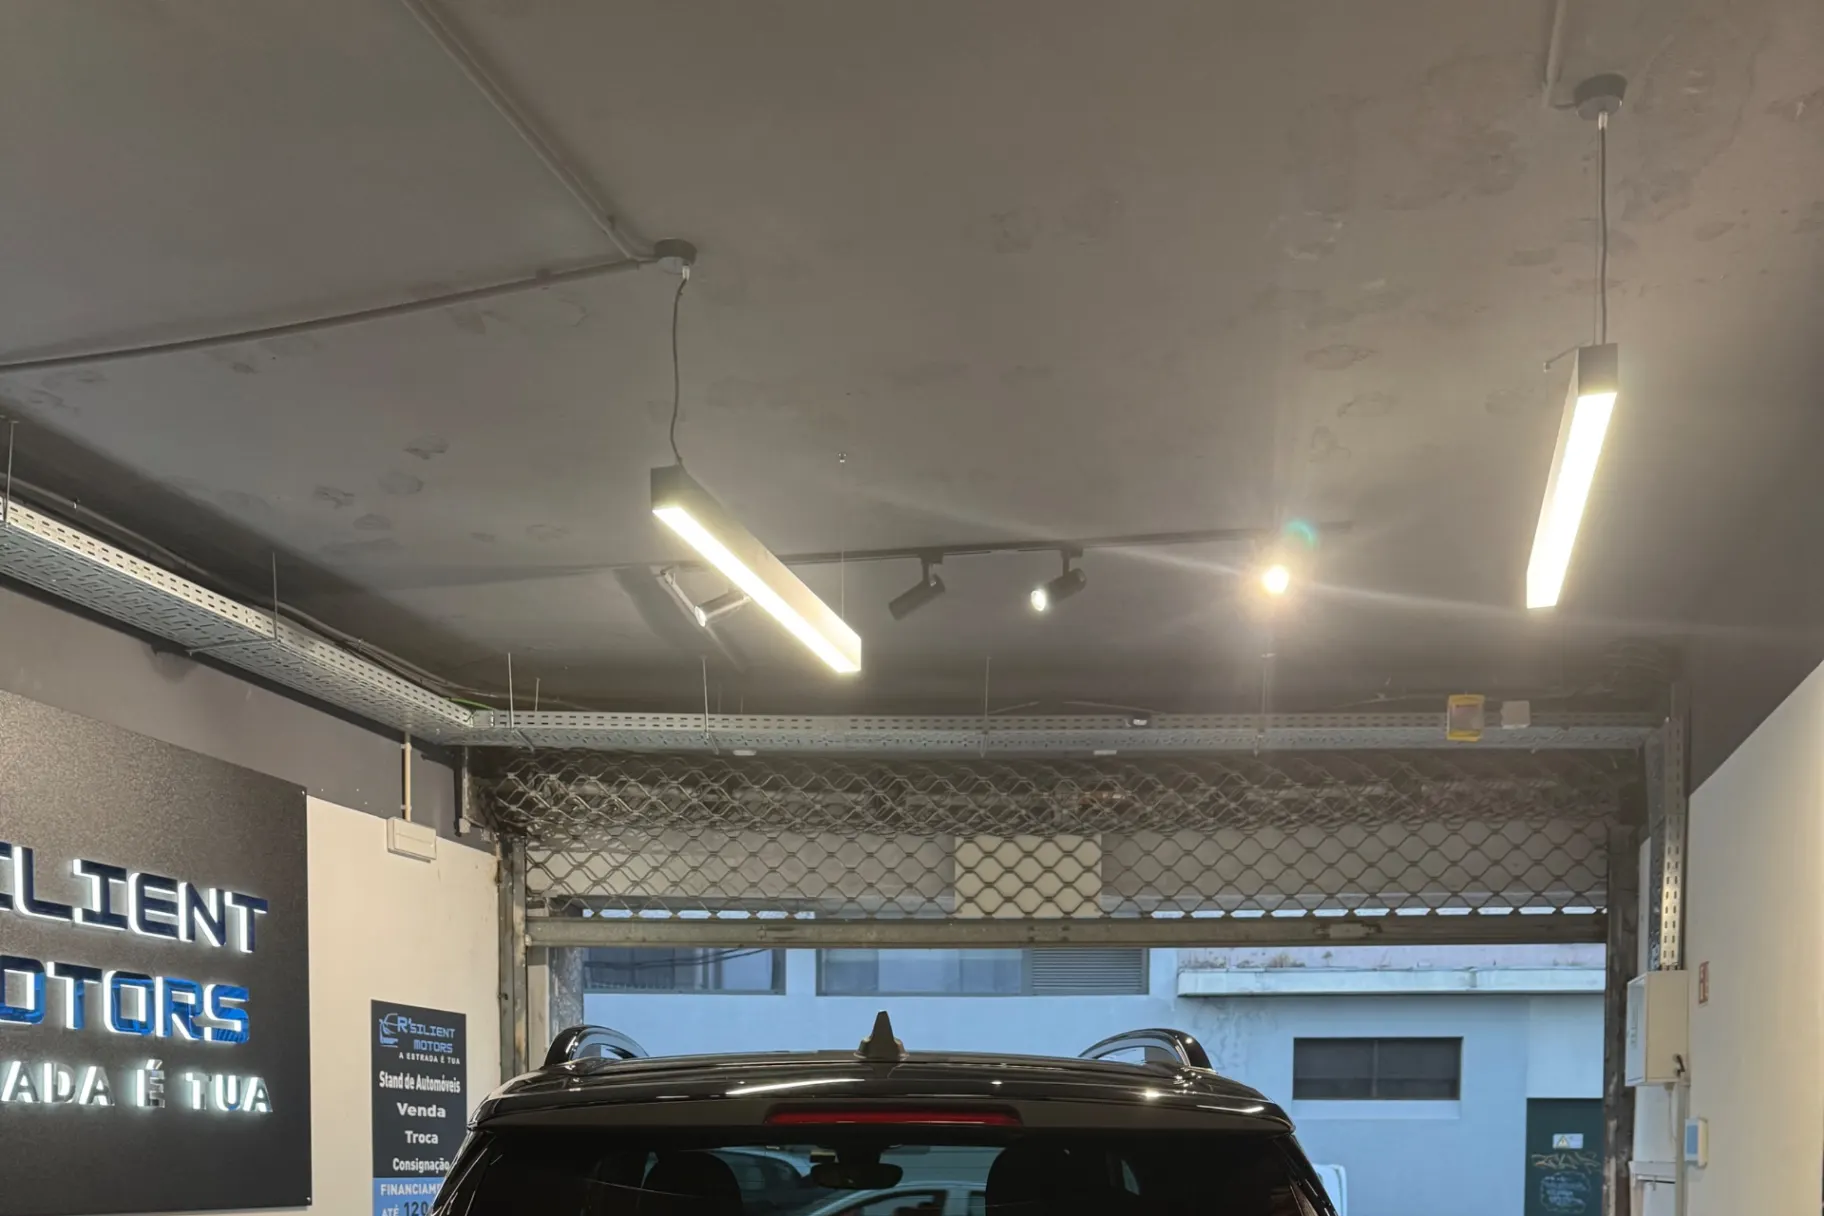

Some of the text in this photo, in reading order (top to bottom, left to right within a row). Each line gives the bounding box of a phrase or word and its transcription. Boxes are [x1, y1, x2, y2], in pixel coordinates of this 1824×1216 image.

[0, 841, 268, 953] LIENT
[413, 1039, 454, 1054] MOTORS
[398, 1051, 404, 1060] A
[405, 1052, 438, 1064] ESTRADA
[447, 1056, 461, 1065] TUA
[136, 1058, 166, 1109] É
[184, 1071, 273, 1113] TUA
[379, 1070, 461, 1094] Stand de Automóveis
[396, 1102, 446, 1118] Venda
[404, 1130, 439, 1145] Troca
[392, 1157, 450, 1174] Consignação
